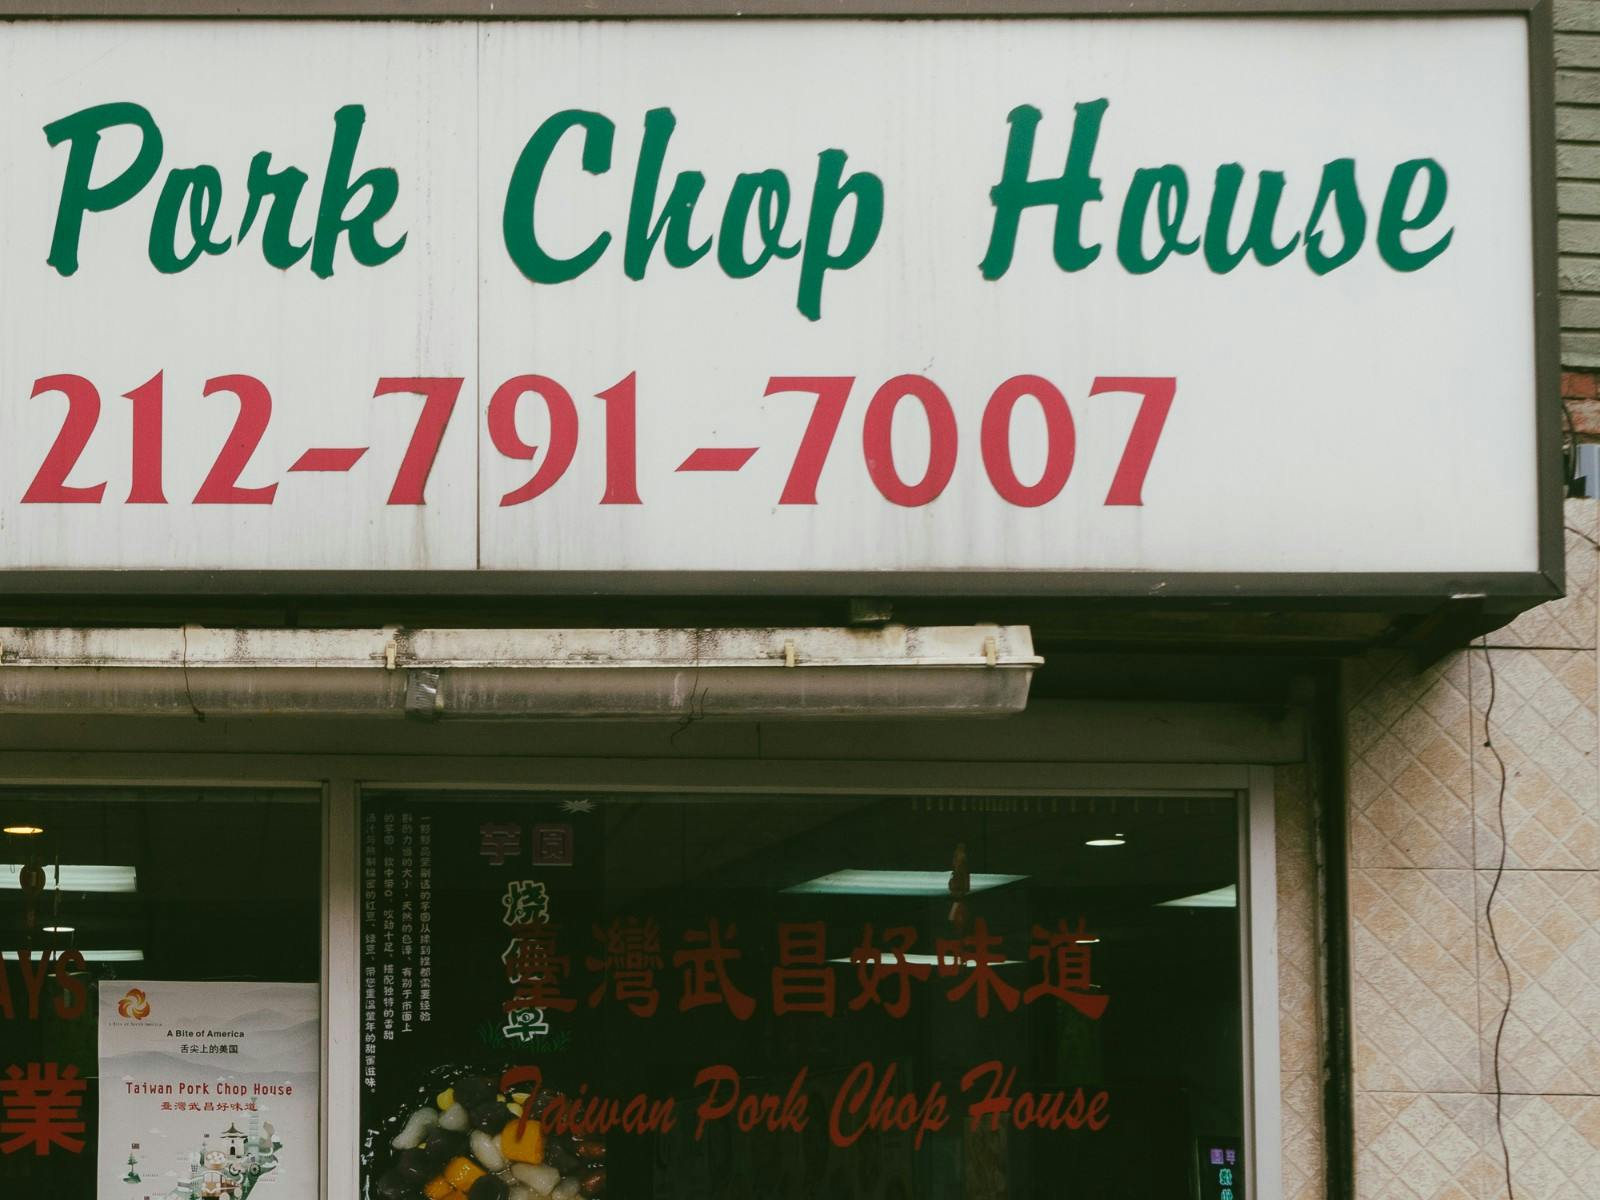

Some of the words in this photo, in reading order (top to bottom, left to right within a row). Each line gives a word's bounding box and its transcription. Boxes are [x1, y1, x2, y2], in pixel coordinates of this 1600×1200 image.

[44, 102, 405, 278] Pork
[503, 108, 885, 320] Chop
[981, 99, 1453, 280] House
[502, 914, 1111, 1022] 臺灣武昌好味道
[166, 1030, 174, 1038] A
[176, 1030, 194, 1038] Bite
[196, 1030, 206, 1038] of
[207, 1030, 245, 1038] America
[180, 1044, 239, 1055] 舌尖上的美国
[126, 1082, 173, 1095] Taiwan
[178, 1081, 209, 1095] Pork
[216, 1083, 247, 1097] Chop
[253, 1083, 293, 1096] House
[499, 1066, 677, 1142] Taiwan
[693, 1064, 810, 1142] Pork
[828, 1060, 951, 1150] Chop
[961, 1059, 1112, 1133] House
